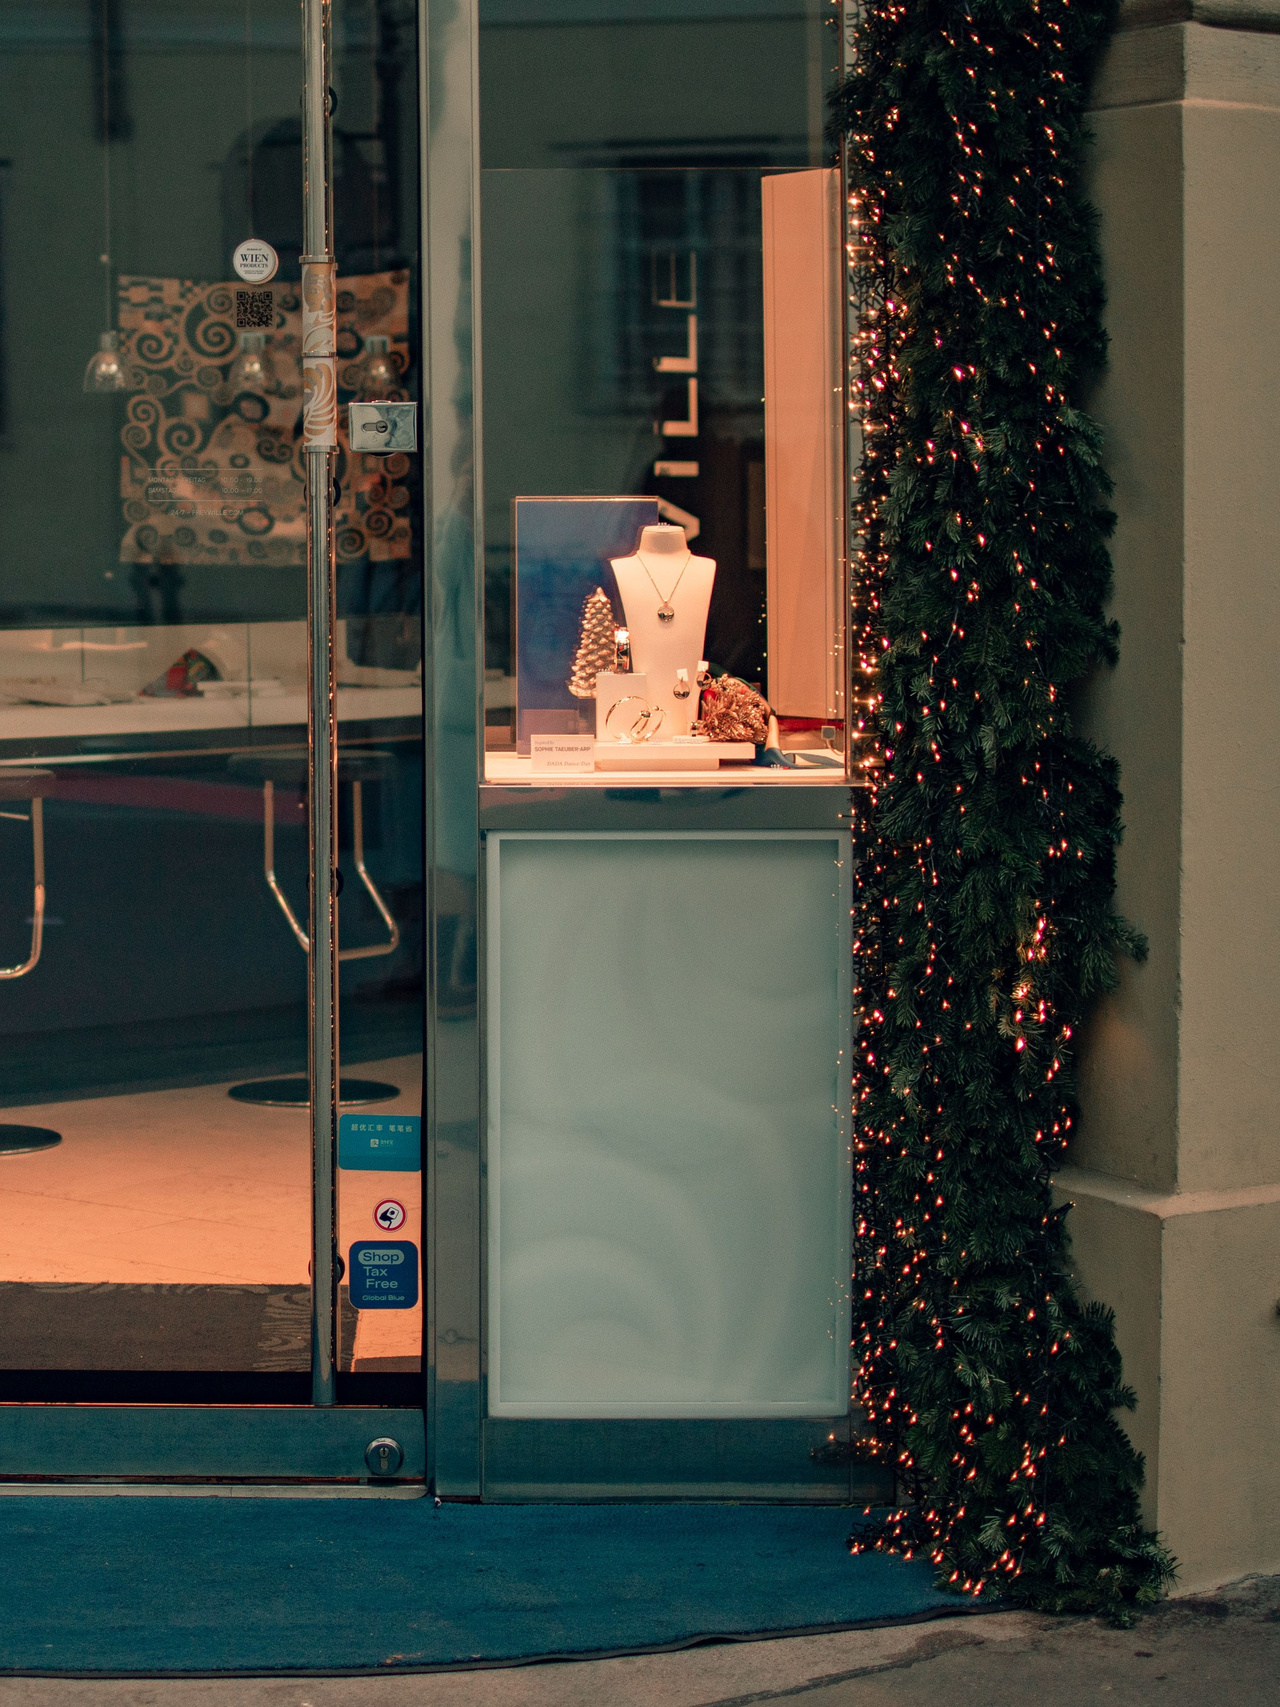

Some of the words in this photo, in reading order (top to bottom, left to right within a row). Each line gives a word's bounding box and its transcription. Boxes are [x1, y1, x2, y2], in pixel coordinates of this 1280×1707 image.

[240, 253, 268, 262] WIEN
[351, 1123, 384, 1132] 超优汇率
[388, 1124, 414, 1133] 笔笔省
[362, 1251, 400, 1264] Shop
[363, 1266, 388, 1277] Tax
[366, 1278, 399, 1289] Free
